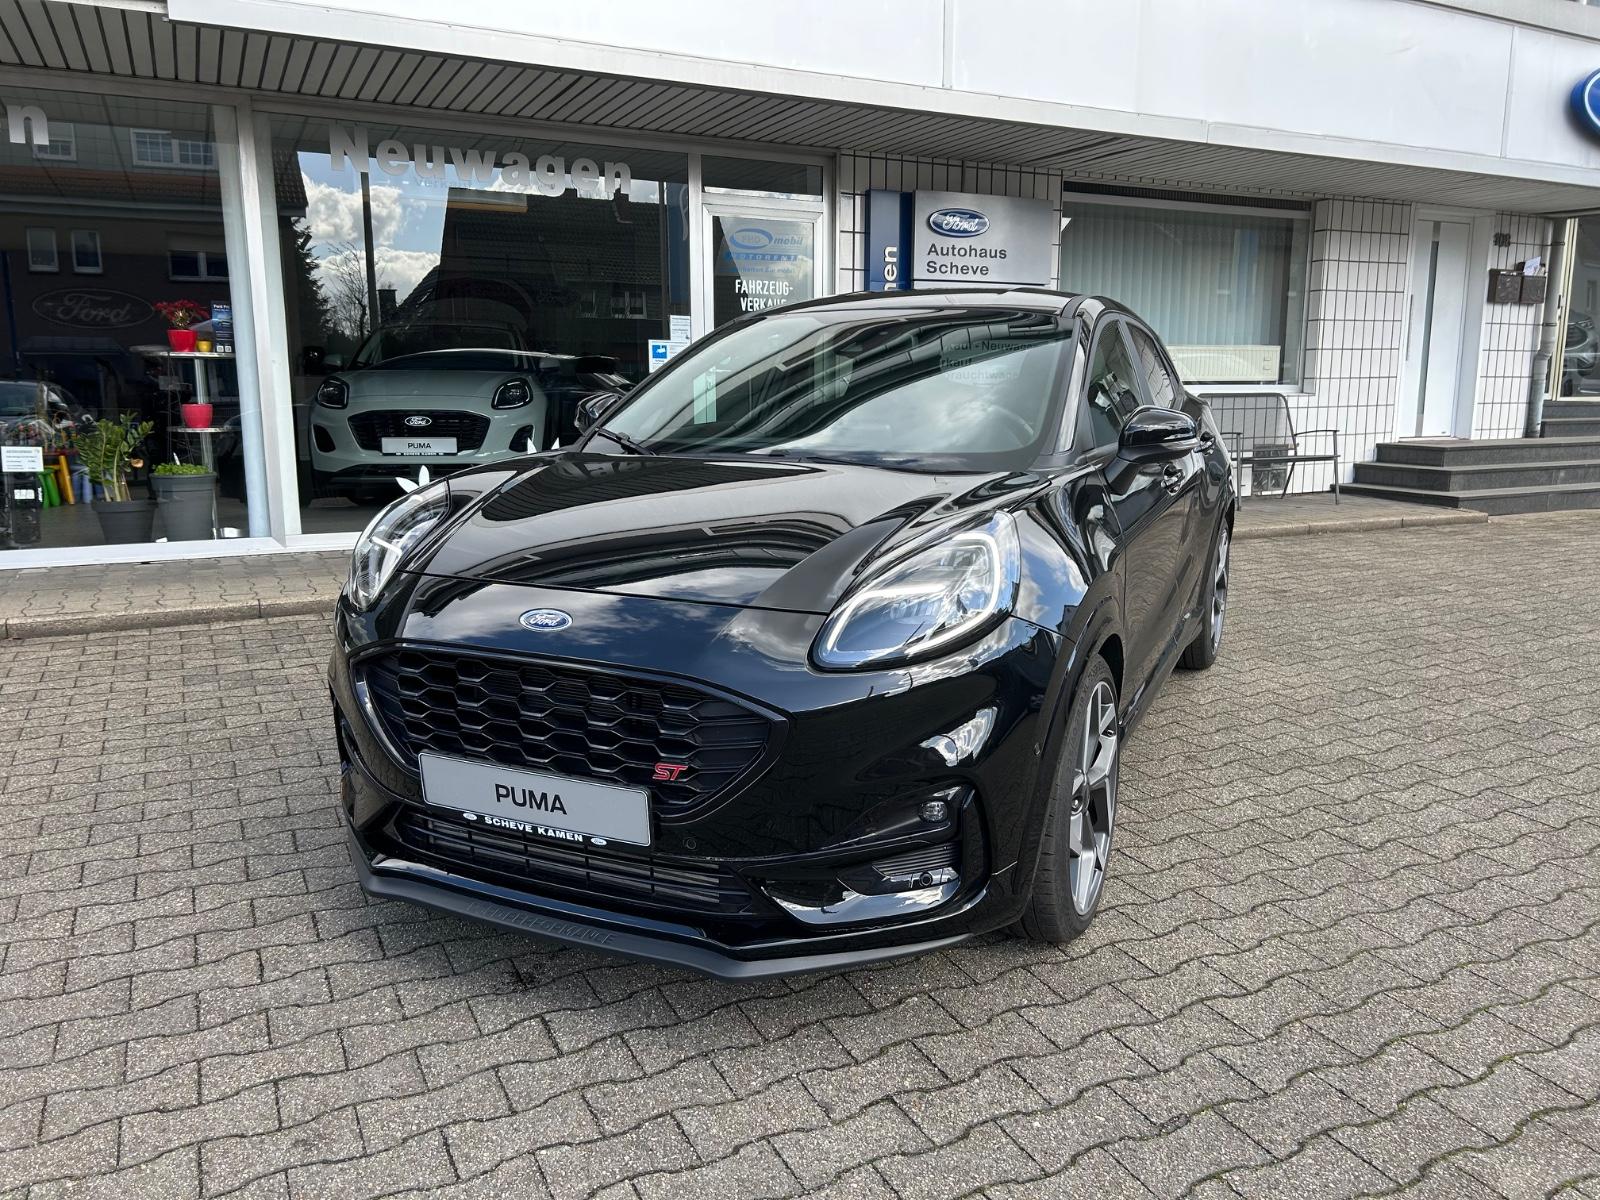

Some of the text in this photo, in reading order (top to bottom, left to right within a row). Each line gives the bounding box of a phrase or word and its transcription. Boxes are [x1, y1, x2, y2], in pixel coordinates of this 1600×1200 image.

[329, 122, 632, 197] Neuwagen
[927, 243, 1007, 259] Autohaus
[926, 261, 989, 275] Scheve
[735, 279, 793, 295] FAHRZEUG-
[56, 293, 131, 322] Ford
[652, 762, 688, 781] ST
[495, 783, 567, 815] PUMA
[484, 816, 533, 833] SCHEVE
[537, 826, 583, 842] KAMEN
